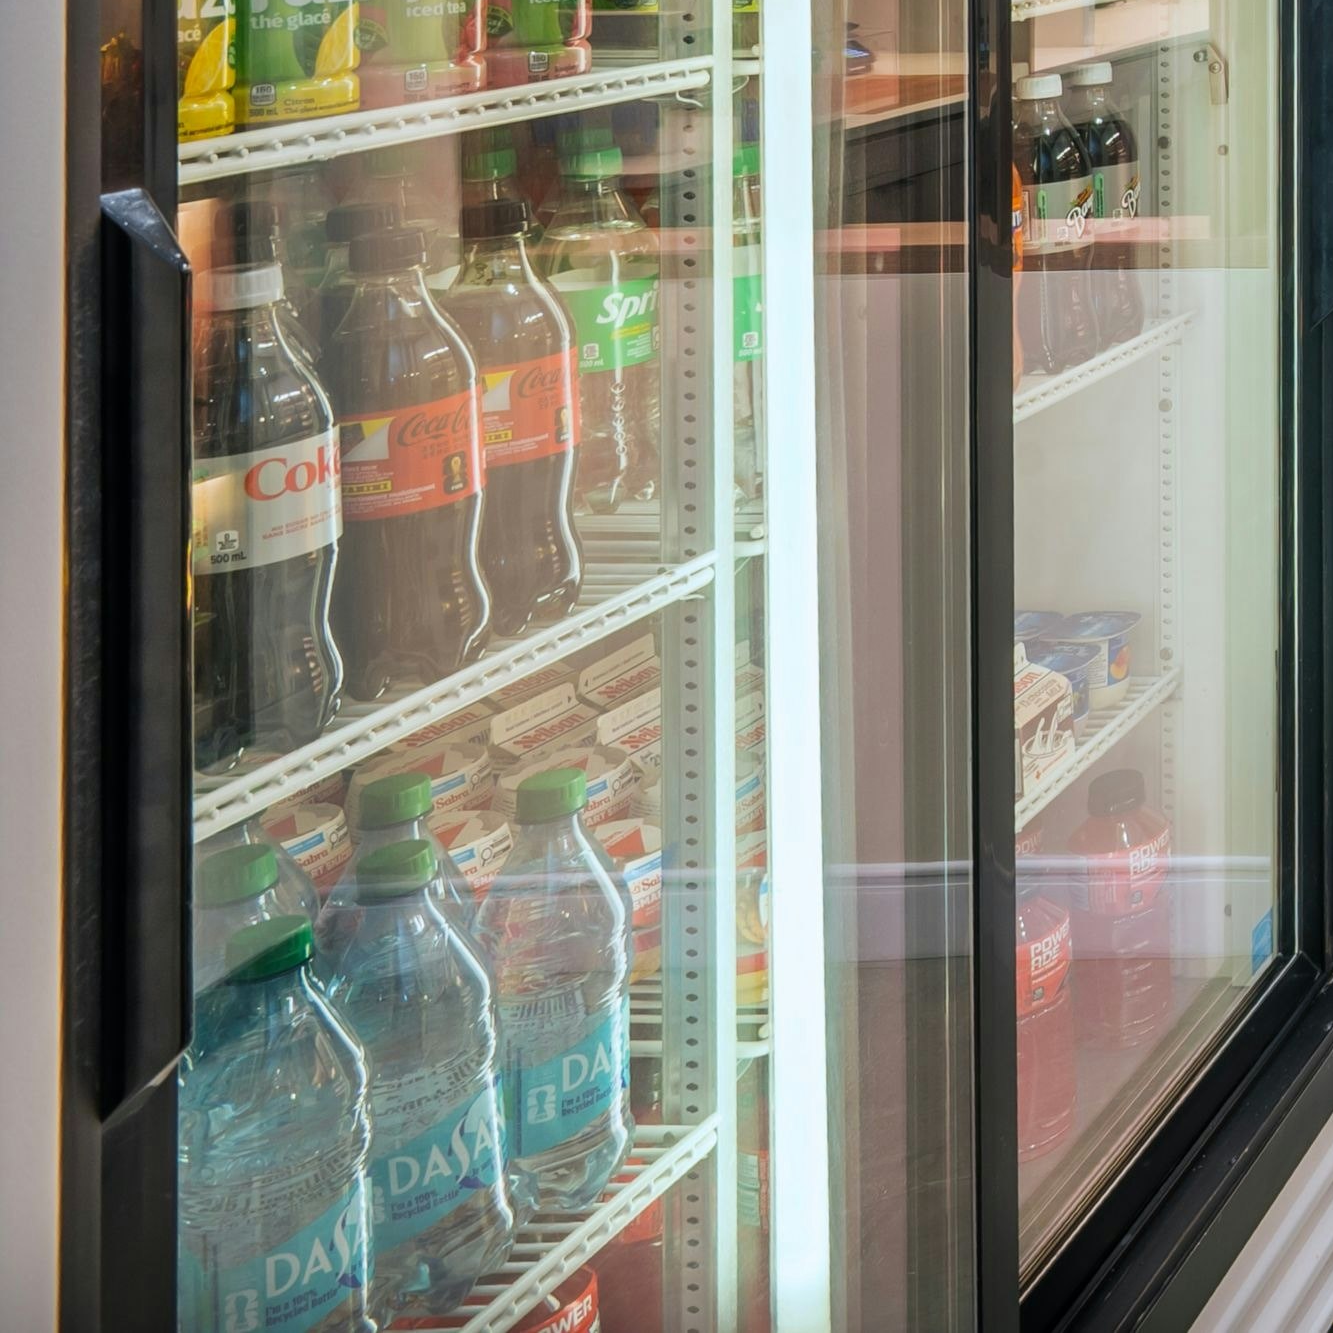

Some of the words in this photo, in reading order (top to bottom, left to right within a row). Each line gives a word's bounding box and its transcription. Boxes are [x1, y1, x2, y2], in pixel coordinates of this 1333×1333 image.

[250, 14, 284, 30] thé
[287, 7, 332, 31] glacé
[406, 4, 444, 17] iced
[447, 0, 467, 13] tea
[596, 279, 660, 327] Spri
[210, 552, 230, 565] 500
[231, 550, 247, 563] mL
[388, 1115, 494, 1196] DASA
